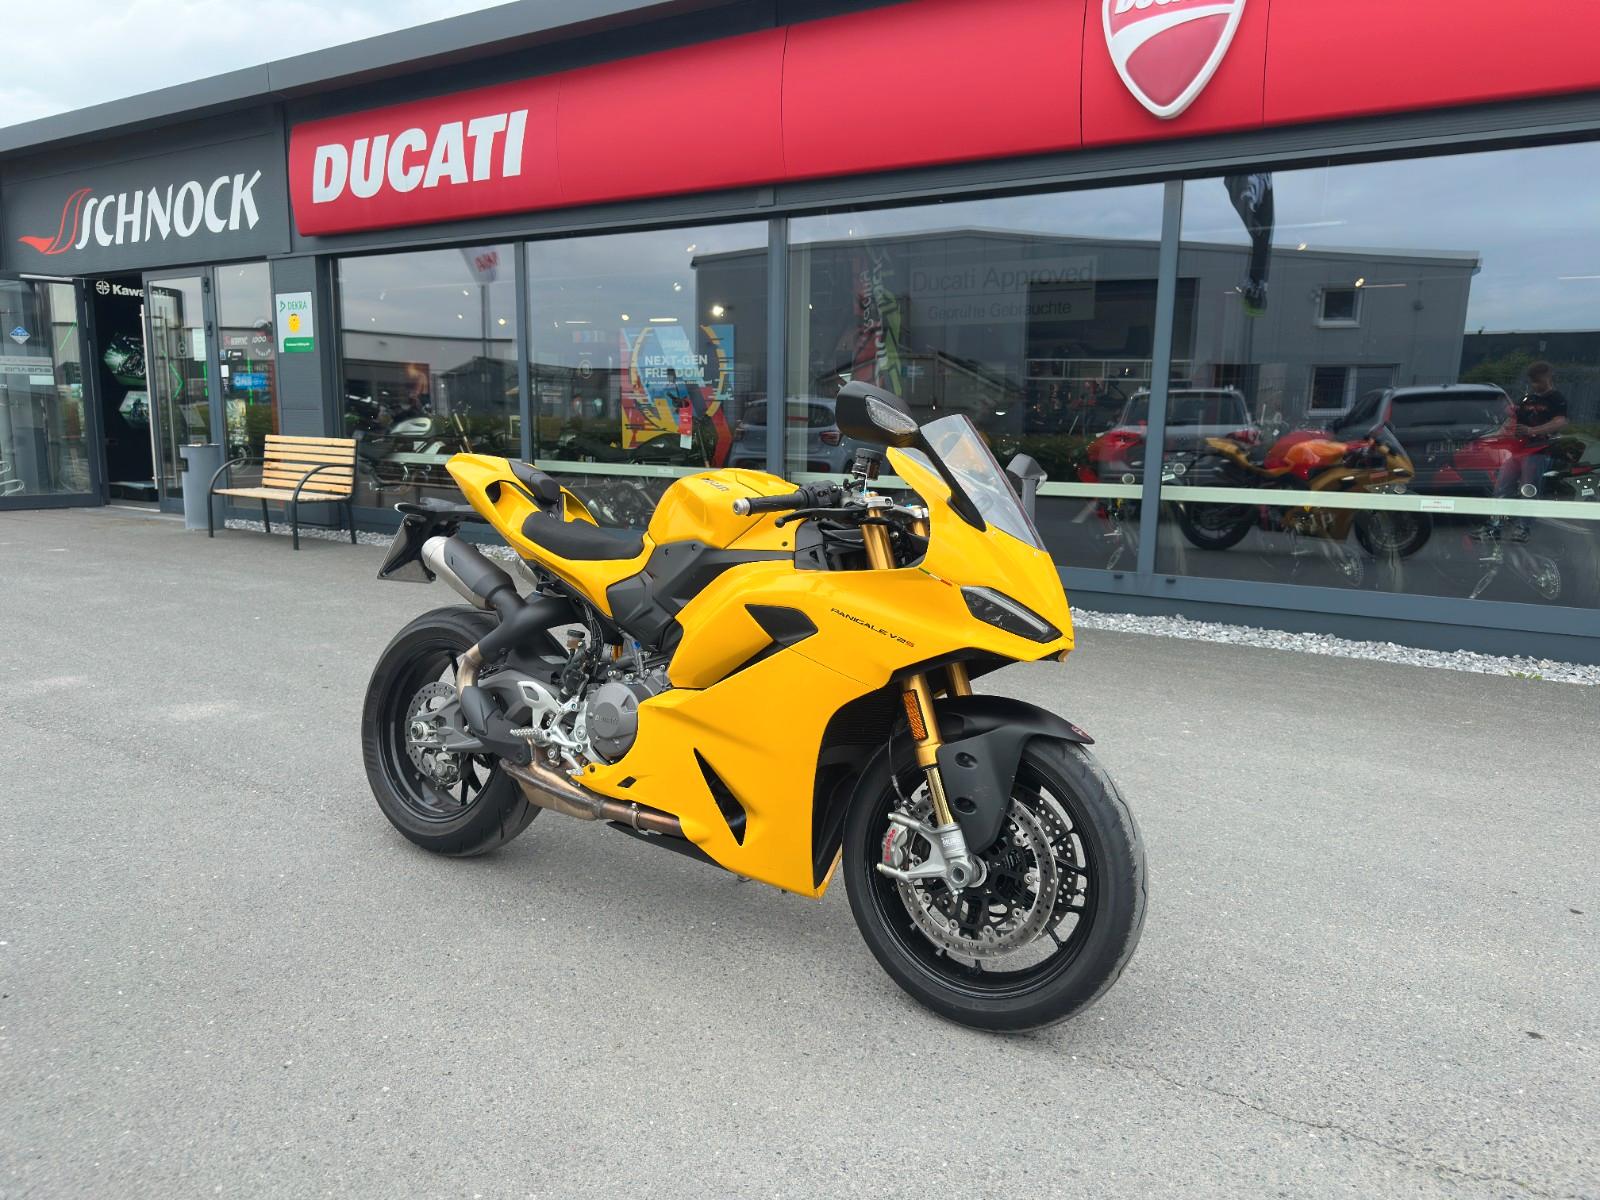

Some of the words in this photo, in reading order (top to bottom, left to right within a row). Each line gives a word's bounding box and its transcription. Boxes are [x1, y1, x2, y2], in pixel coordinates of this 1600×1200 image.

[312, 109, 529, 205] DUCATI
[75, 169, 262, 251] SCHNOCK
[912, 268, 977, 292] Ducati
[983, 259, 1094, 291] Approved
[287, 301, 308, 310] DEKRA
[989, 299, 1073, 318] Gebrauchte
[644, 354, 708, 366] NEXT-GEN
[644, 367, 705, 378] FREDOM
[830, 607, 889, 636] PANIGALE
